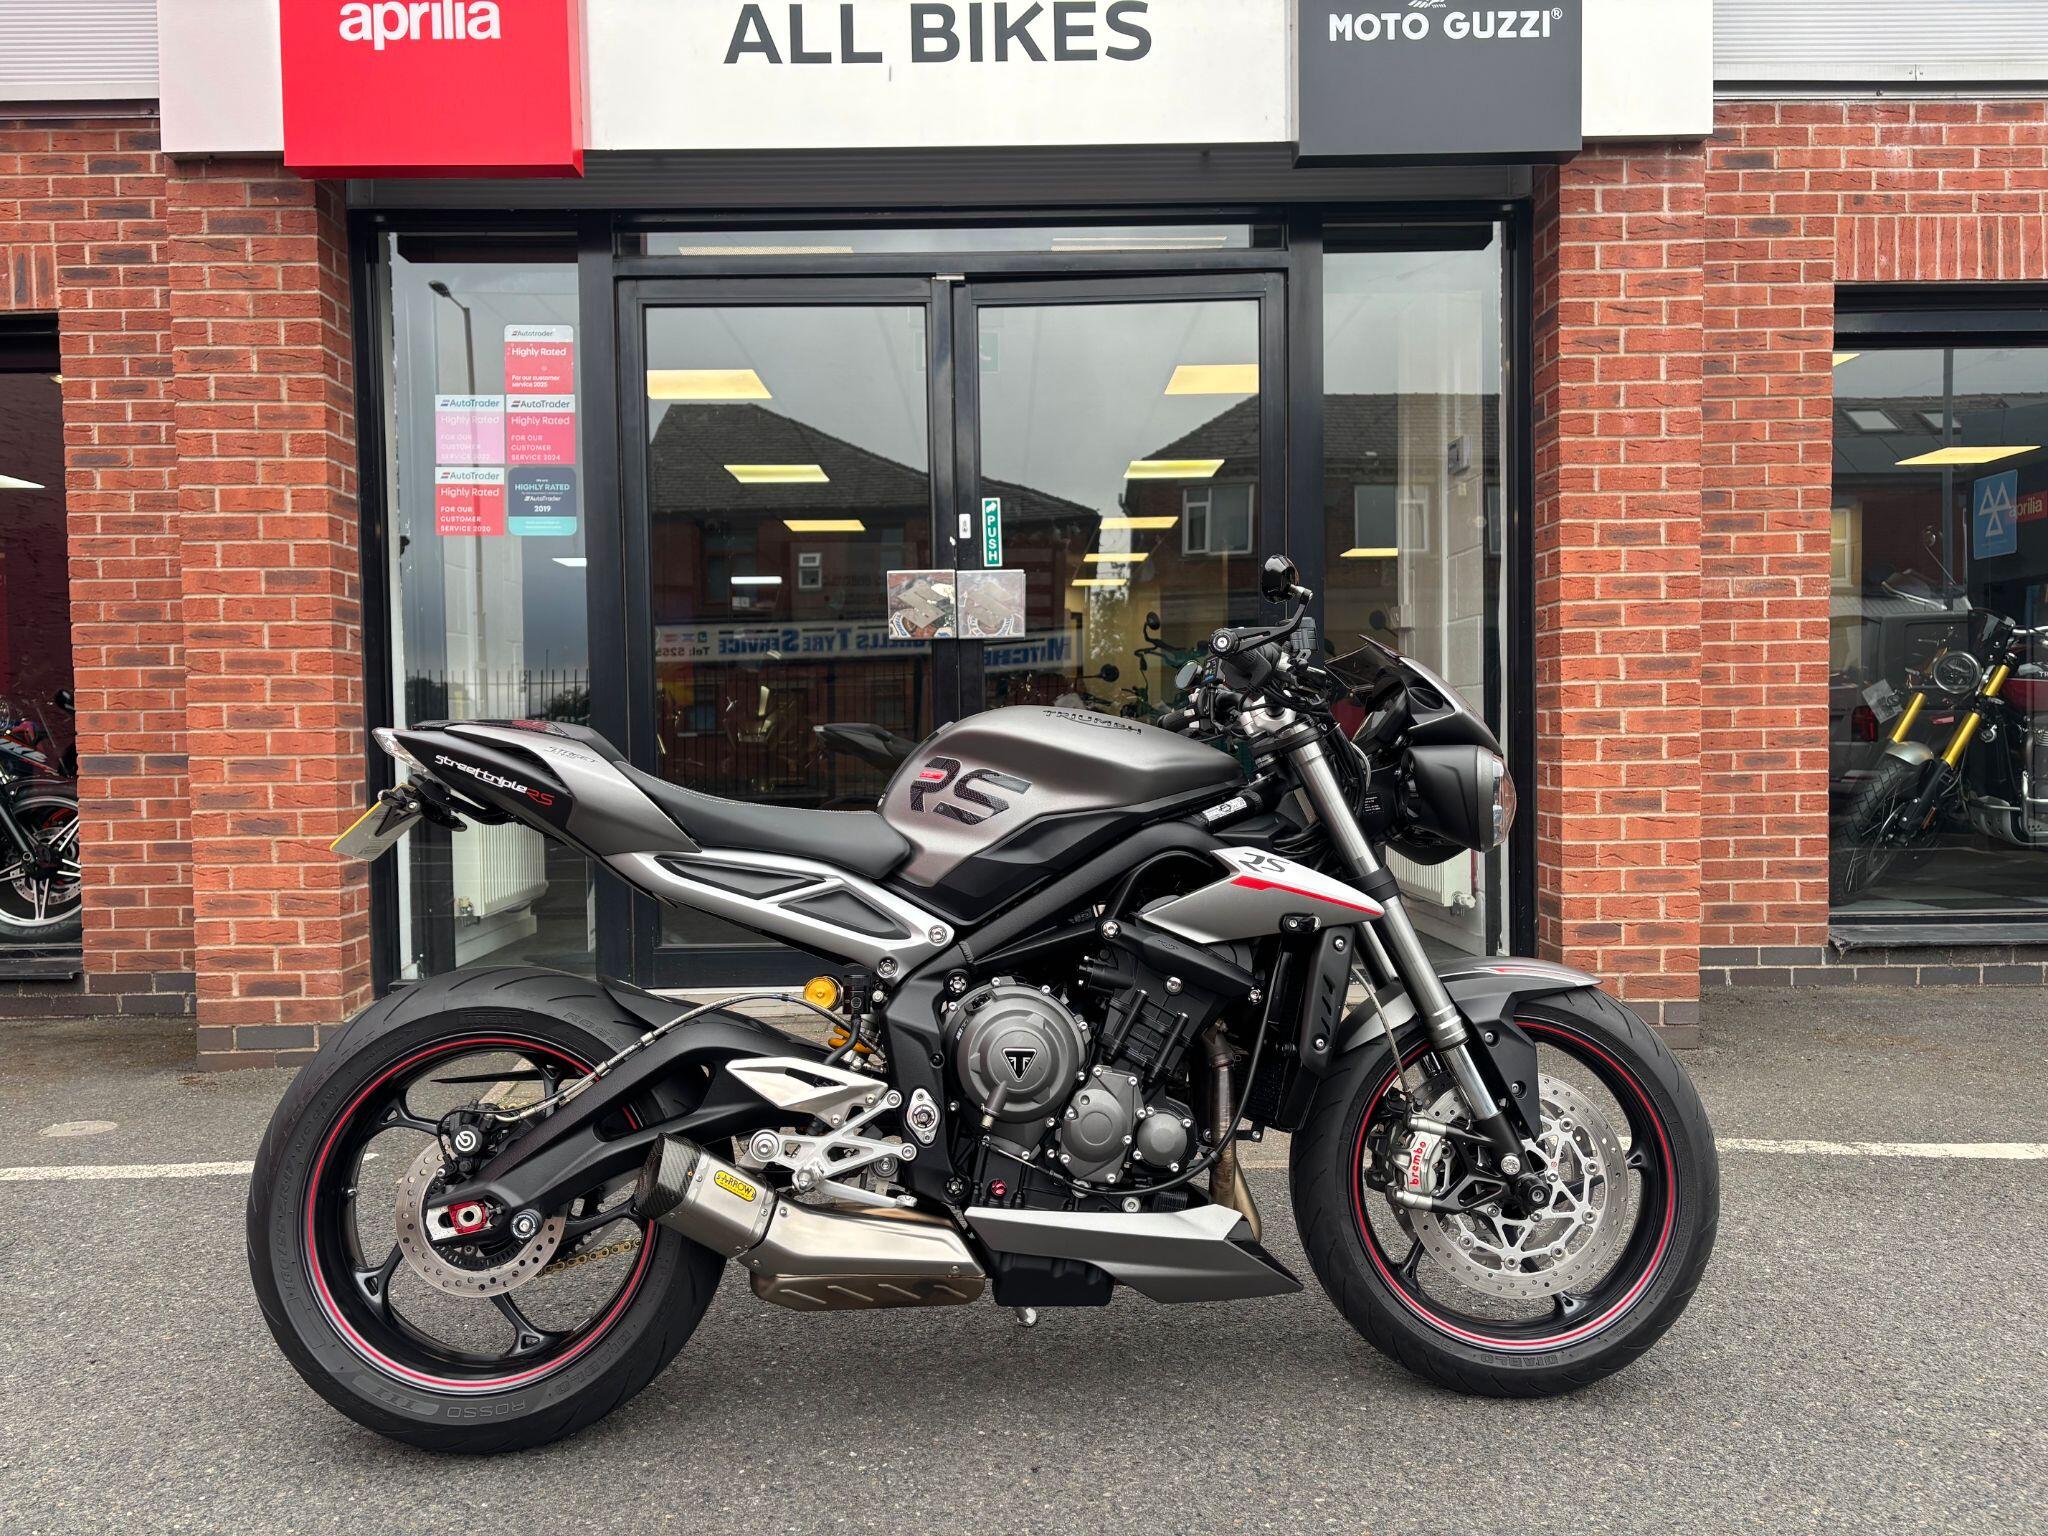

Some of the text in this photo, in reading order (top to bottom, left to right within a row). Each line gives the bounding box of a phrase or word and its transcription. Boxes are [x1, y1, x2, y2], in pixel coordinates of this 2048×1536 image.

[338, 0, 502, 50] aprilia
[1328, 12, 1430, 42] MOTO
[723, 1, 1152, 64] ALL BIKES
[511, 347, 567, 358] Highly Rated
[449, 399, 500, 408] AutoTrader
[520, 399, 570, 408] AutoTrader
[440, 415, 500, 426] Highly Rated
[511, 415, 570, 427] Highly Rated
[449, 471, 500, 480] AutoTrader
[440, 487, 500, 498] Highly Rated
[514, 483, 570, 491] HIGHLY RATED
[533, 505, 552, 513] 2019
[986, 514, 998, 562] PUSH
[1042, 709, 1142, 735] TRIUMPH
[909, 755, 1033, 827] RS
[1238, 851, 1293, 874] RS
[1409, 1141, 1427, 1186] brembo
